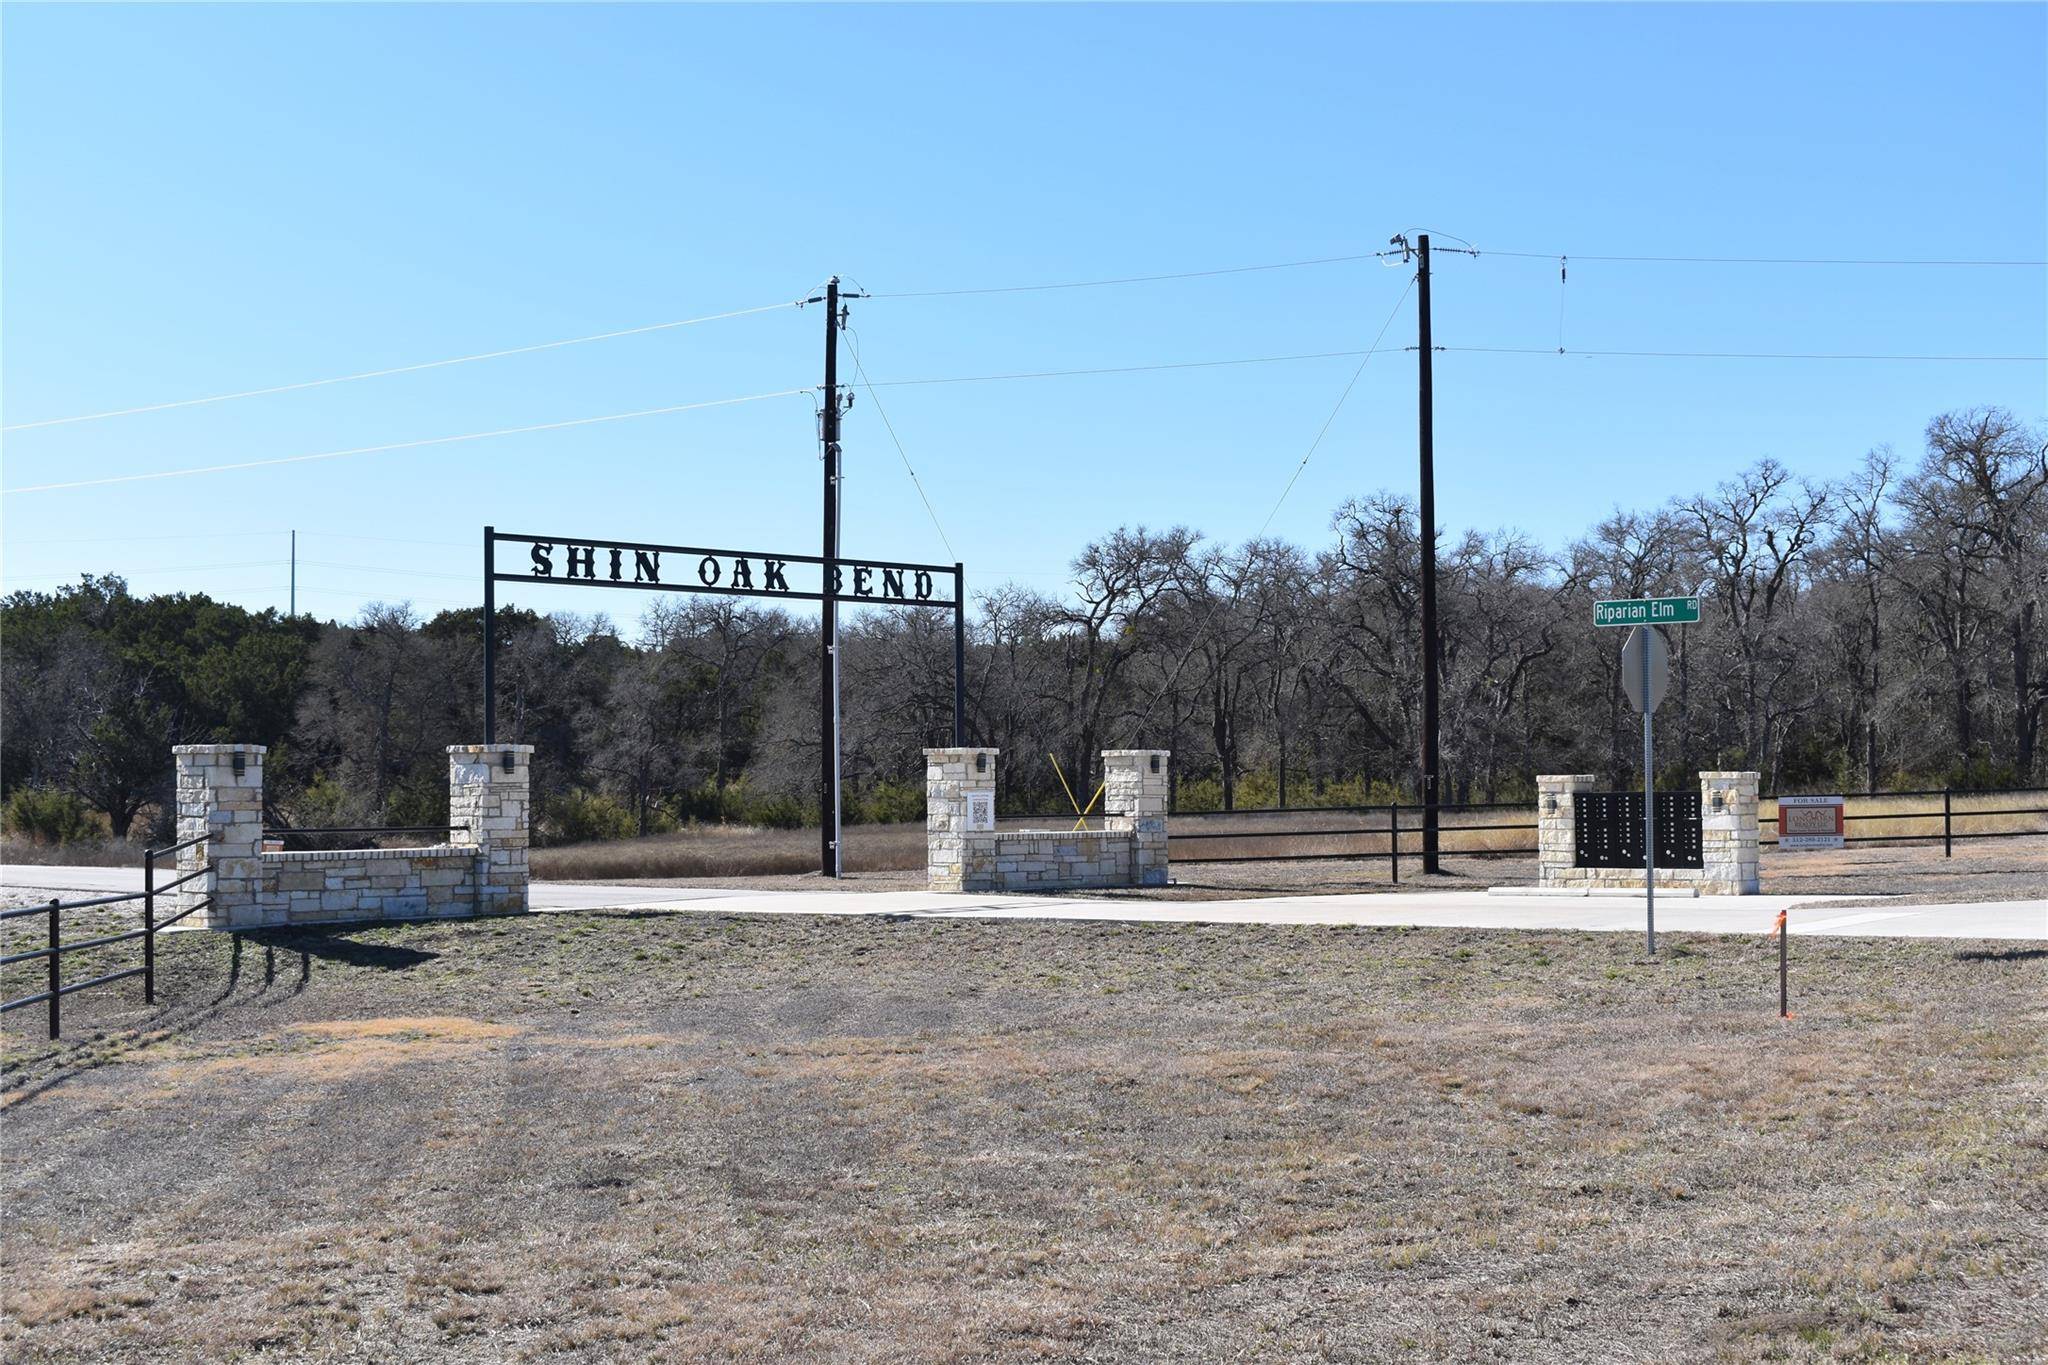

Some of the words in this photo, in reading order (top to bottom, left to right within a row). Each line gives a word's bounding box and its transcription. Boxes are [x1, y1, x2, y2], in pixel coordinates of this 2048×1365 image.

[530, 542, 661, 584] SHIN
[697, 555, 790, 591] OAK
[826, 566, 933, 600] BEND
[1596, 603, 1646, 622] Riparian
[1651, 602, 1674, 617] Elm
[1686, 600, 1697, 610] RD
